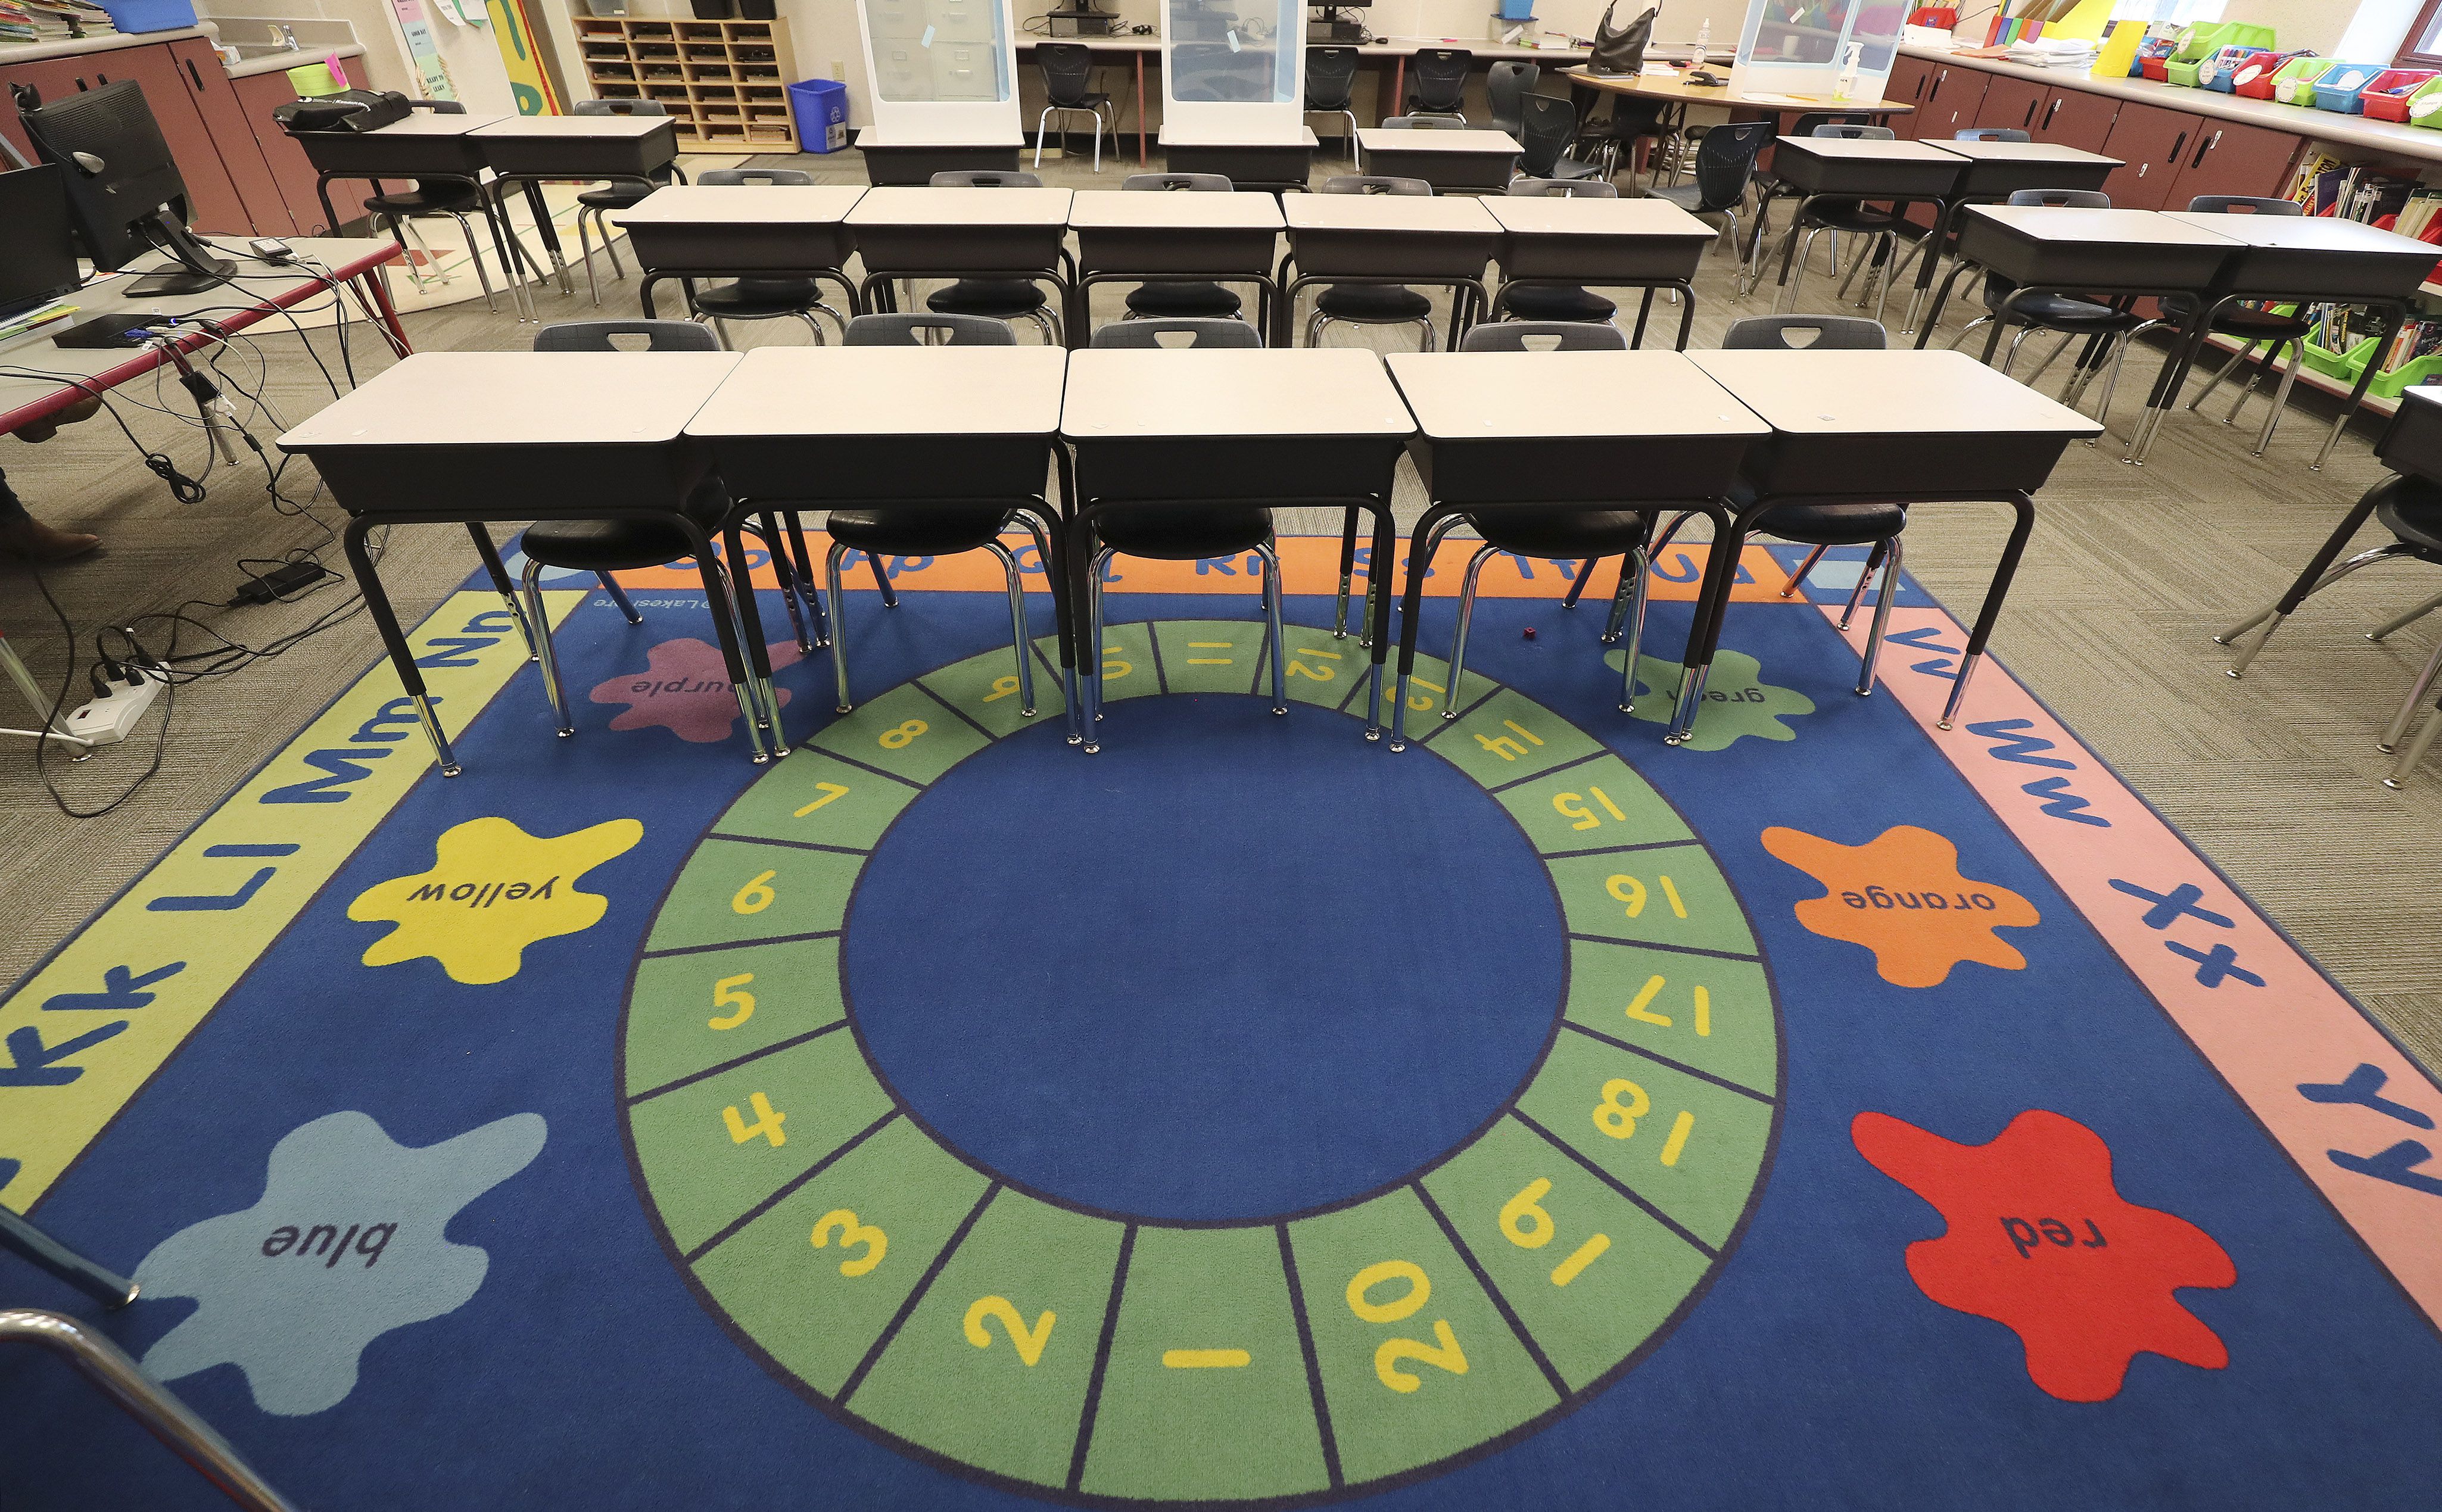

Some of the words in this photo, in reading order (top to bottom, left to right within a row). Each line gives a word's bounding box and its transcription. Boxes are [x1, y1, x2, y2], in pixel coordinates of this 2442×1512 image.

[593, 599, 699, 609] Lakesre
[1285, 648, 1342, 682] 12
[1665, 687, 1765, 703] gre
[879, 720, 928, 749] 8
[1475, 721, 1544, 760] 14
[794, 783, 849, 817] 7
[1553, 787, 1626, 830] 15
[406, 876, 560, 909] yellow
[731, 870, 775, 914] 6
[1606, 874, 1687, 918] 16
[1841, 886, 1996, 911] orange
[708, 973, 755, 1030] 5
[1626, 975, 1711, 1037] 17
[722, 1092, 786, 1147] 4
[1593, 1078, 1695, 1166] 18
[262, 1222, 398, 1270] blue
[811, 1209, 888, 1277] 3
[1499, 1177, 1611, 1286] 19
[1999, 1216, 2108, 1260] red
[963, 1296, 1056, 1366] 2
[1346, 1260, 1469, 1393] 20
[1163, 1349, 1251, 1368] 1
